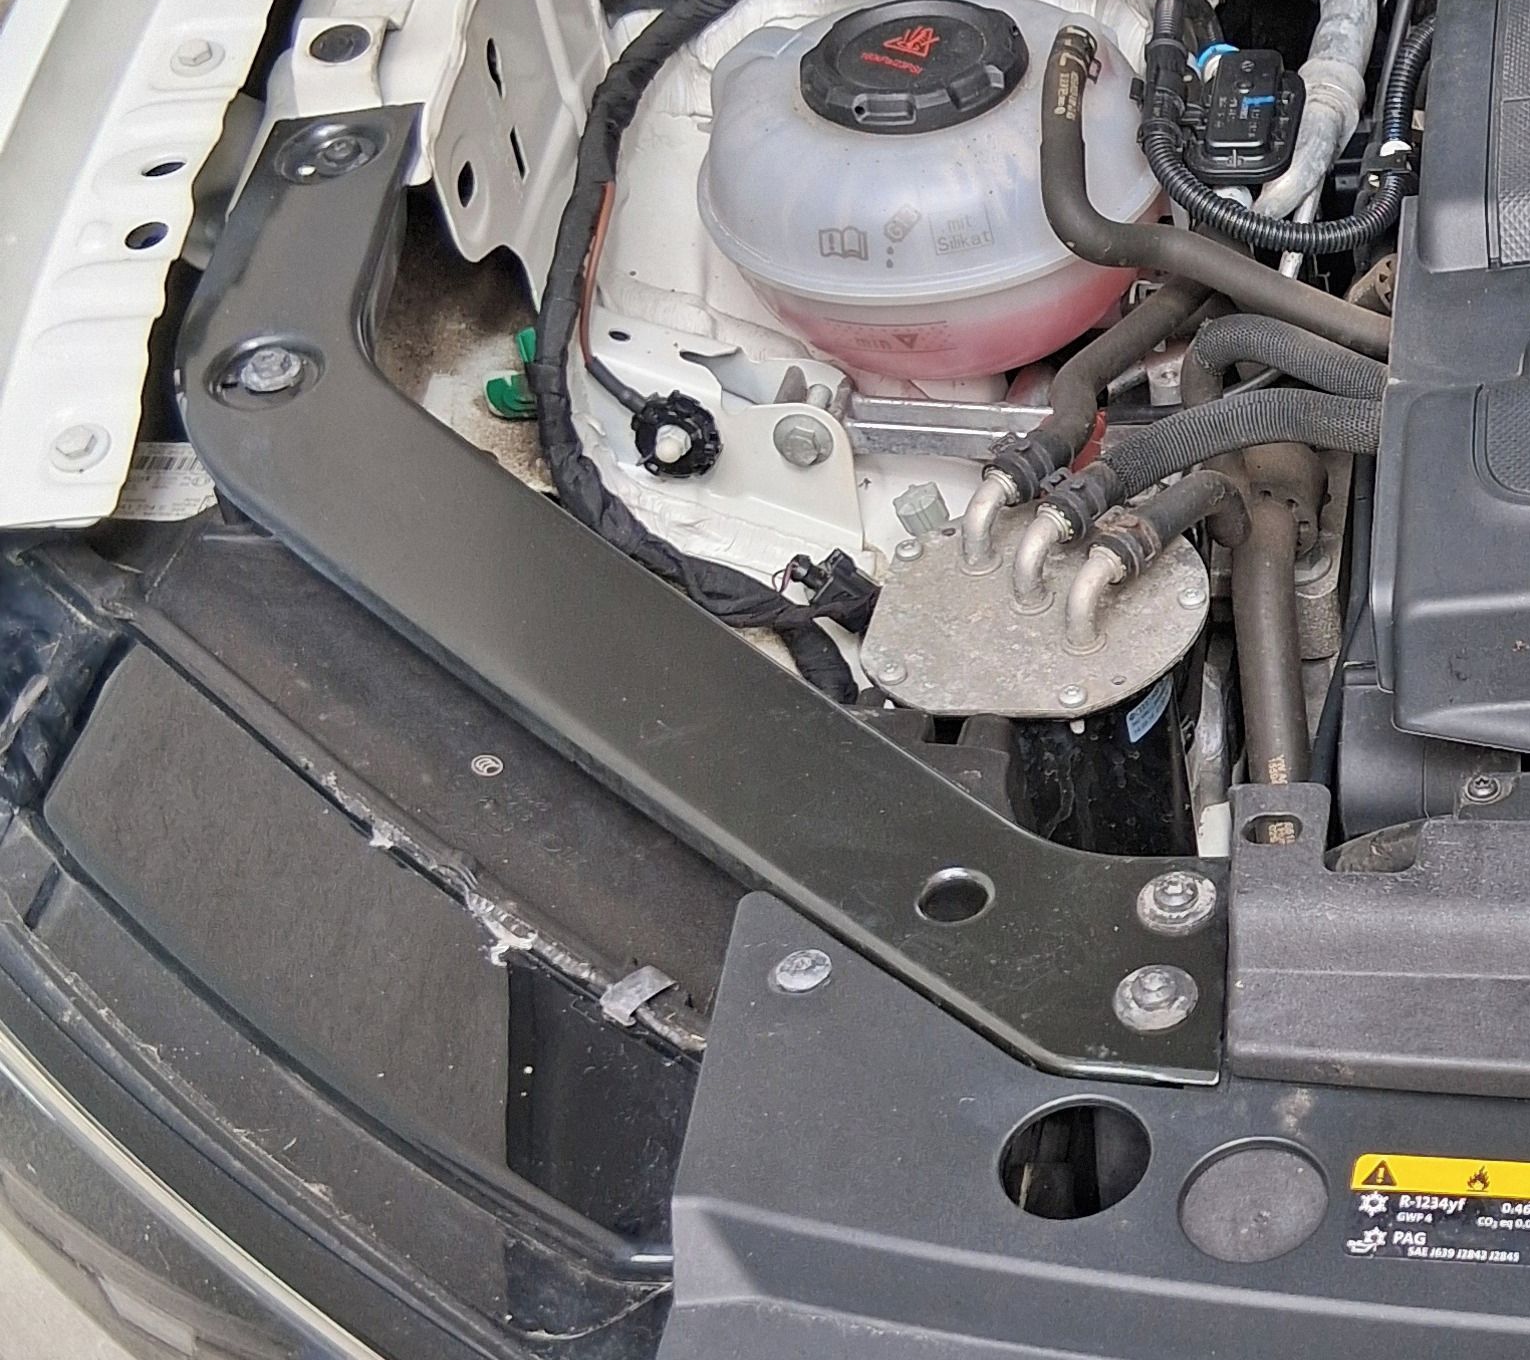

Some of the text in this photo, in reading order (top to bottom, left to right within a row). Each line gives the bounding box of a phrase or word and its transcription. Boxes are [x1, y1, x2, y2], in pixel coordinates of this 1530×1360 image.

[938, 231, 992, 252] Silikat
[1399, 1194, 1467, 1214] R-1234yf
[1396, 1211, 1424, 1223] GWP
[1424, 1213, 1433, 1223] 4
[1392, 1230, 1428, 1246] PAG
[1407, 1246, 1429, 1257] SAE
